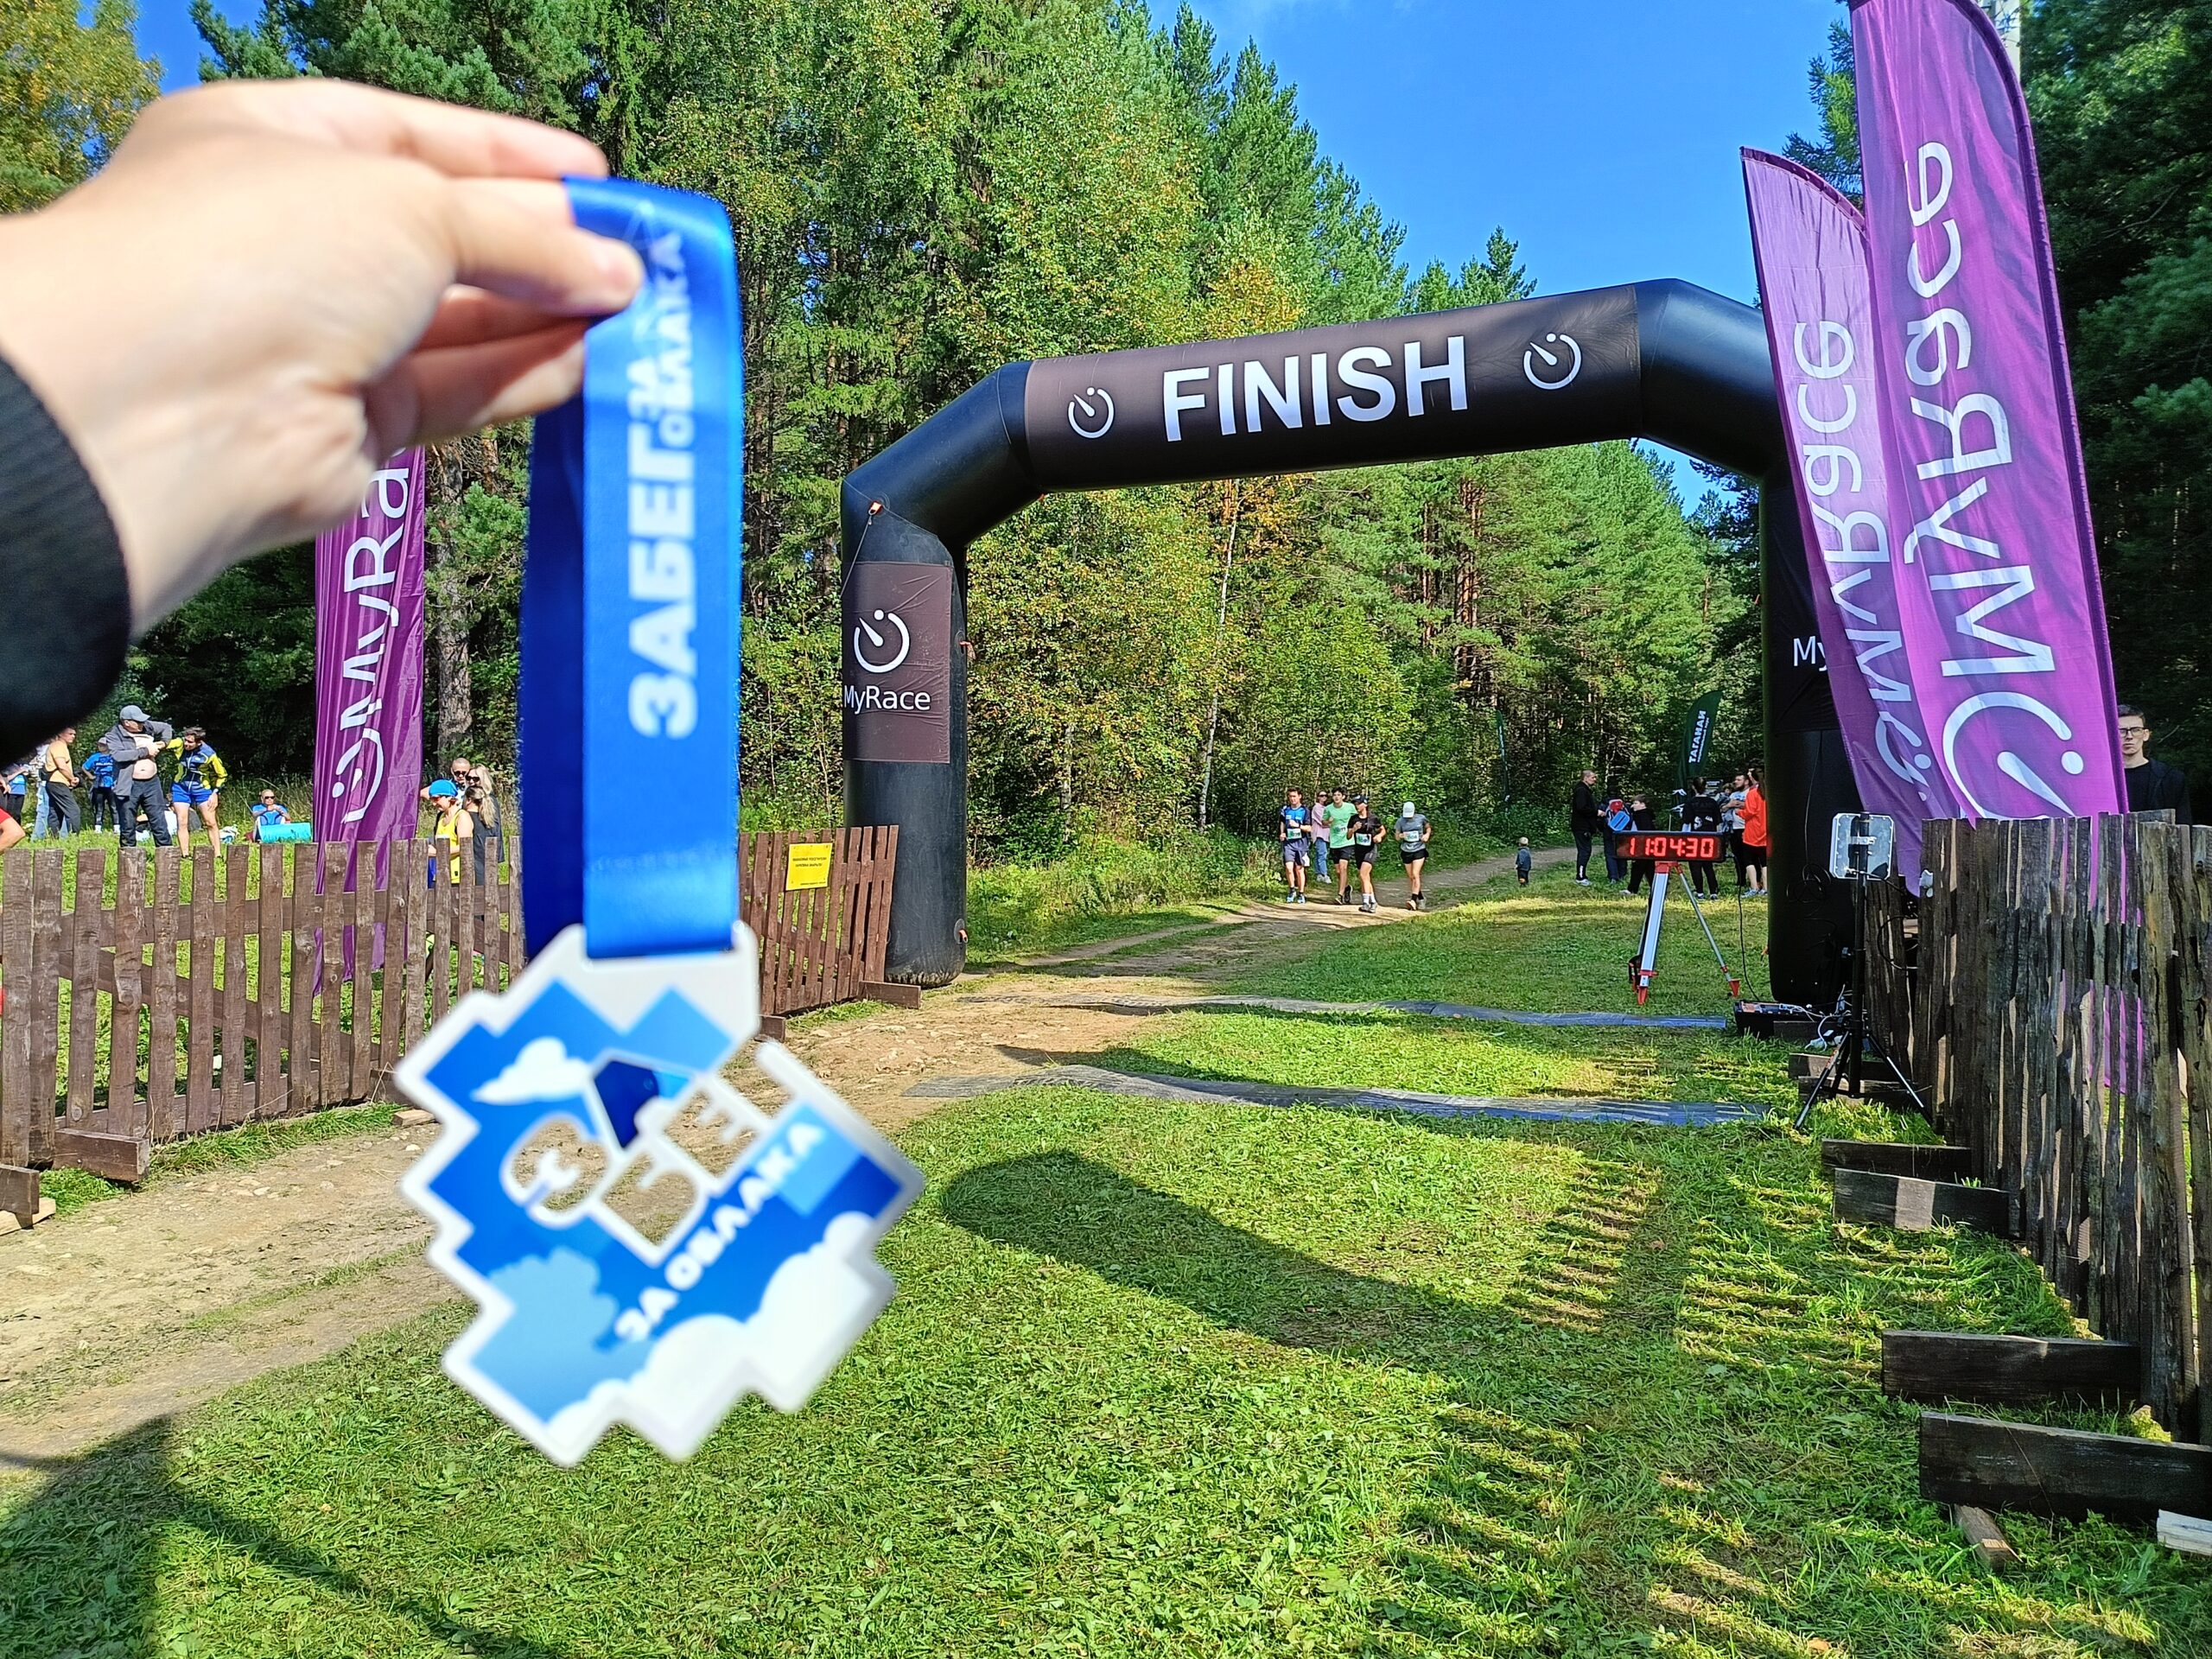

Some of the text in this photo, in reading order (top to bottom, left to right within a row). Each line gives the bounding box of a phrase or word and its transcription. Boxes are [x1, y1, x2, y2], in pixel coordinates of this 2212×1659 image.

[626, 356, 659, 418] ЗА
[1162, 335, 1468, 442] FINISH
[340, 446, 410, 732] MyRa
[627, 421, 697, 739] ЗАБЕГ
[843, 685, 931, 715] MyRace
[613, 1123, 827, 1343] ЗА ОБЛАКА
